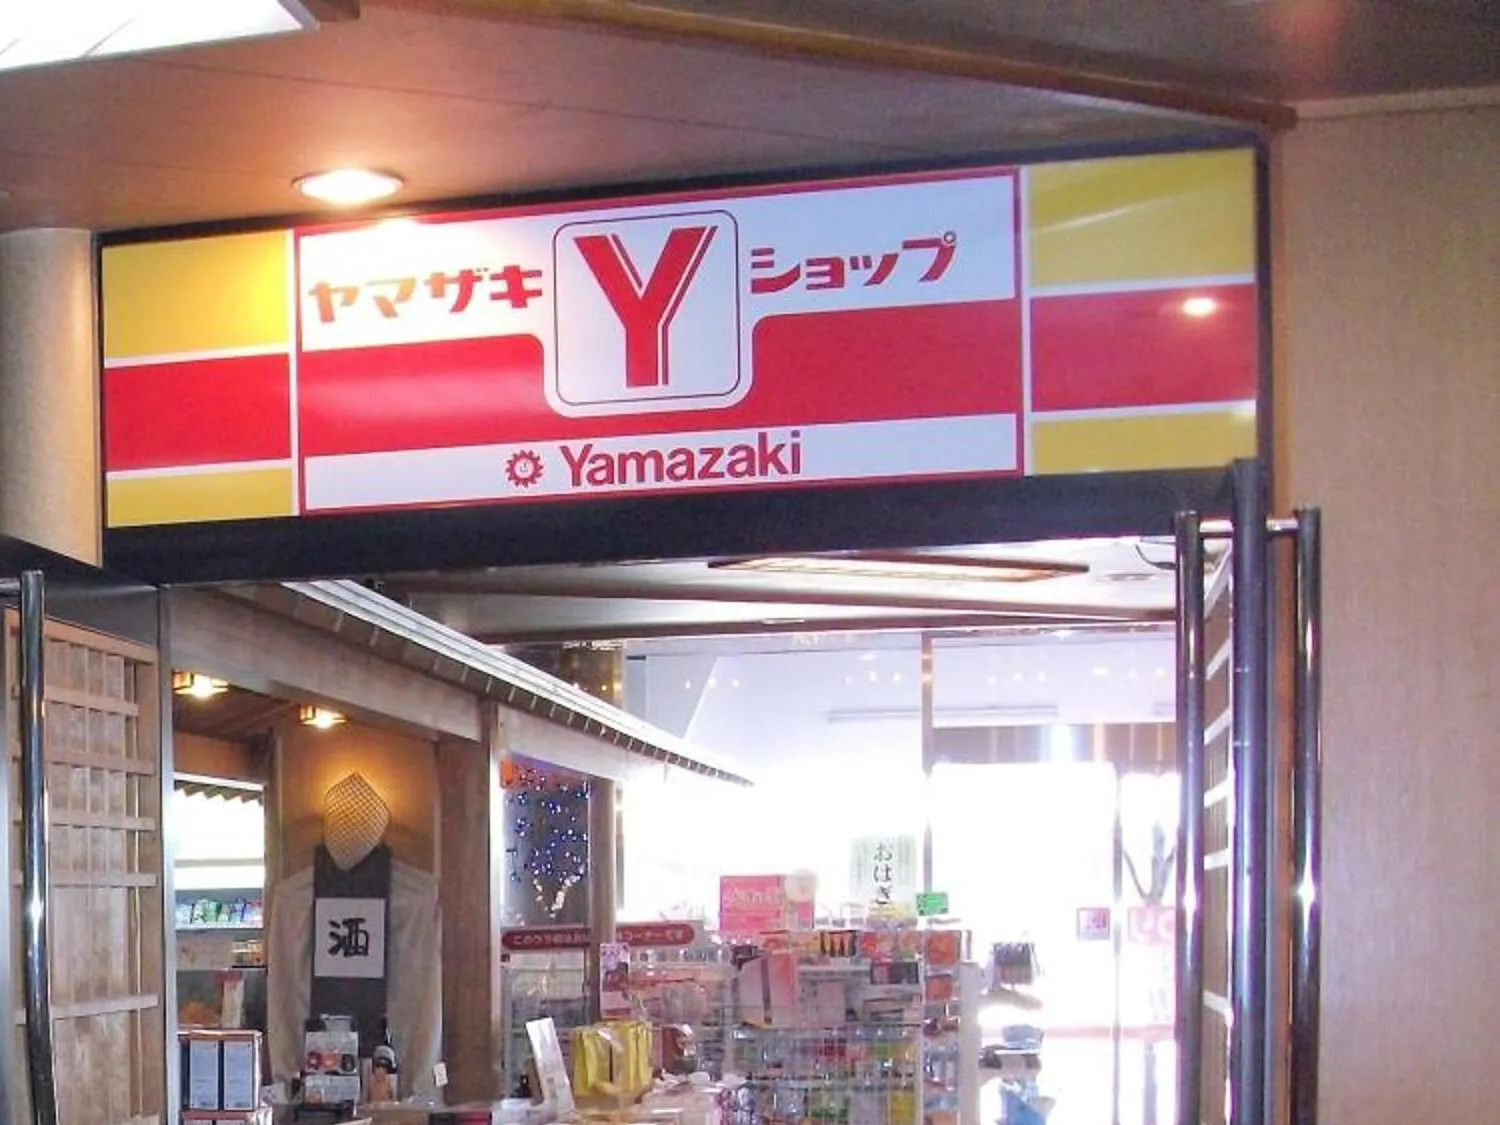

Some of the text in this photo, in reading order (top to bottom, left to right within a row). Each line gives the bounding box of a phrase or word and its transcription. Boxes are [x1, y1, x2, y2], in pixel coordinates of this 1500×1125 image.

[308, 224, 959, 388] ヤマザキ Y ショップ
[561, 430, 802, 485] Yamazaki
[327, 917, 369, 957] 酒
